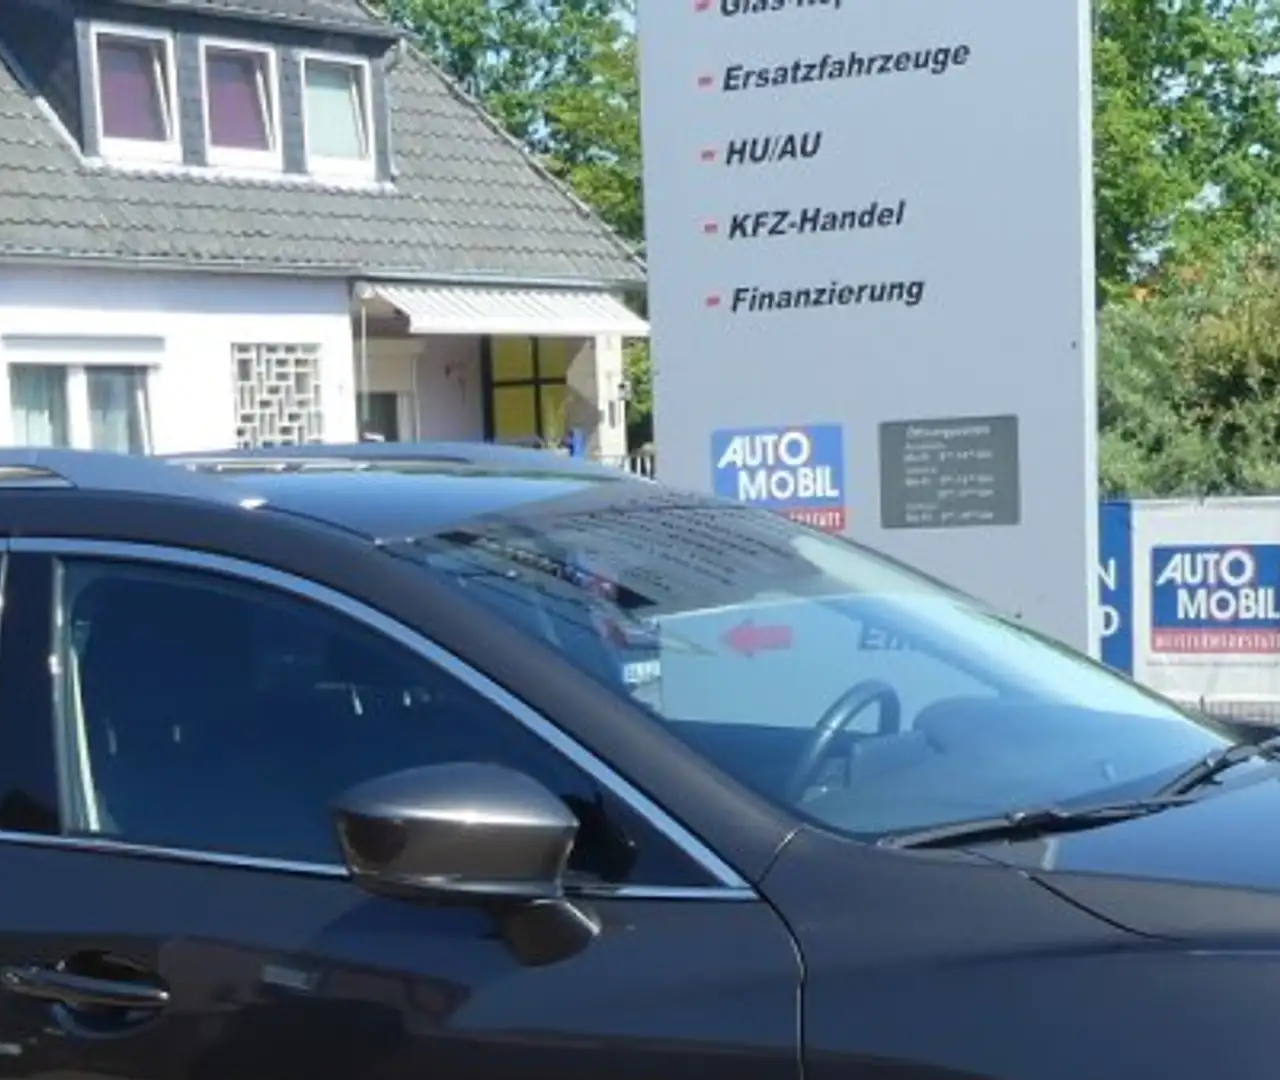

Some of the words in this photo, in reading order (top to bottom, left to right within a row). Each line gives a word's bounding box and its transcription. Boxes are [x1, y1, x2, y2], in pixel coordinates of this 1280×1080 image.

[723, 44, 971, 91] Ersatzfahrzeuge
[726, 131, 822, 165] HU/AU
[728, 199, 906, 240] KFZ-Handel
[731, 279, 925, 313] Finanzierung
[717, 432, 810, 469] AUTO
[739, 465, 839, 501] MOBIL
[1156, 550, 1253, 587] AUTO
[1177, 588, 1280, 622] MOBIL
